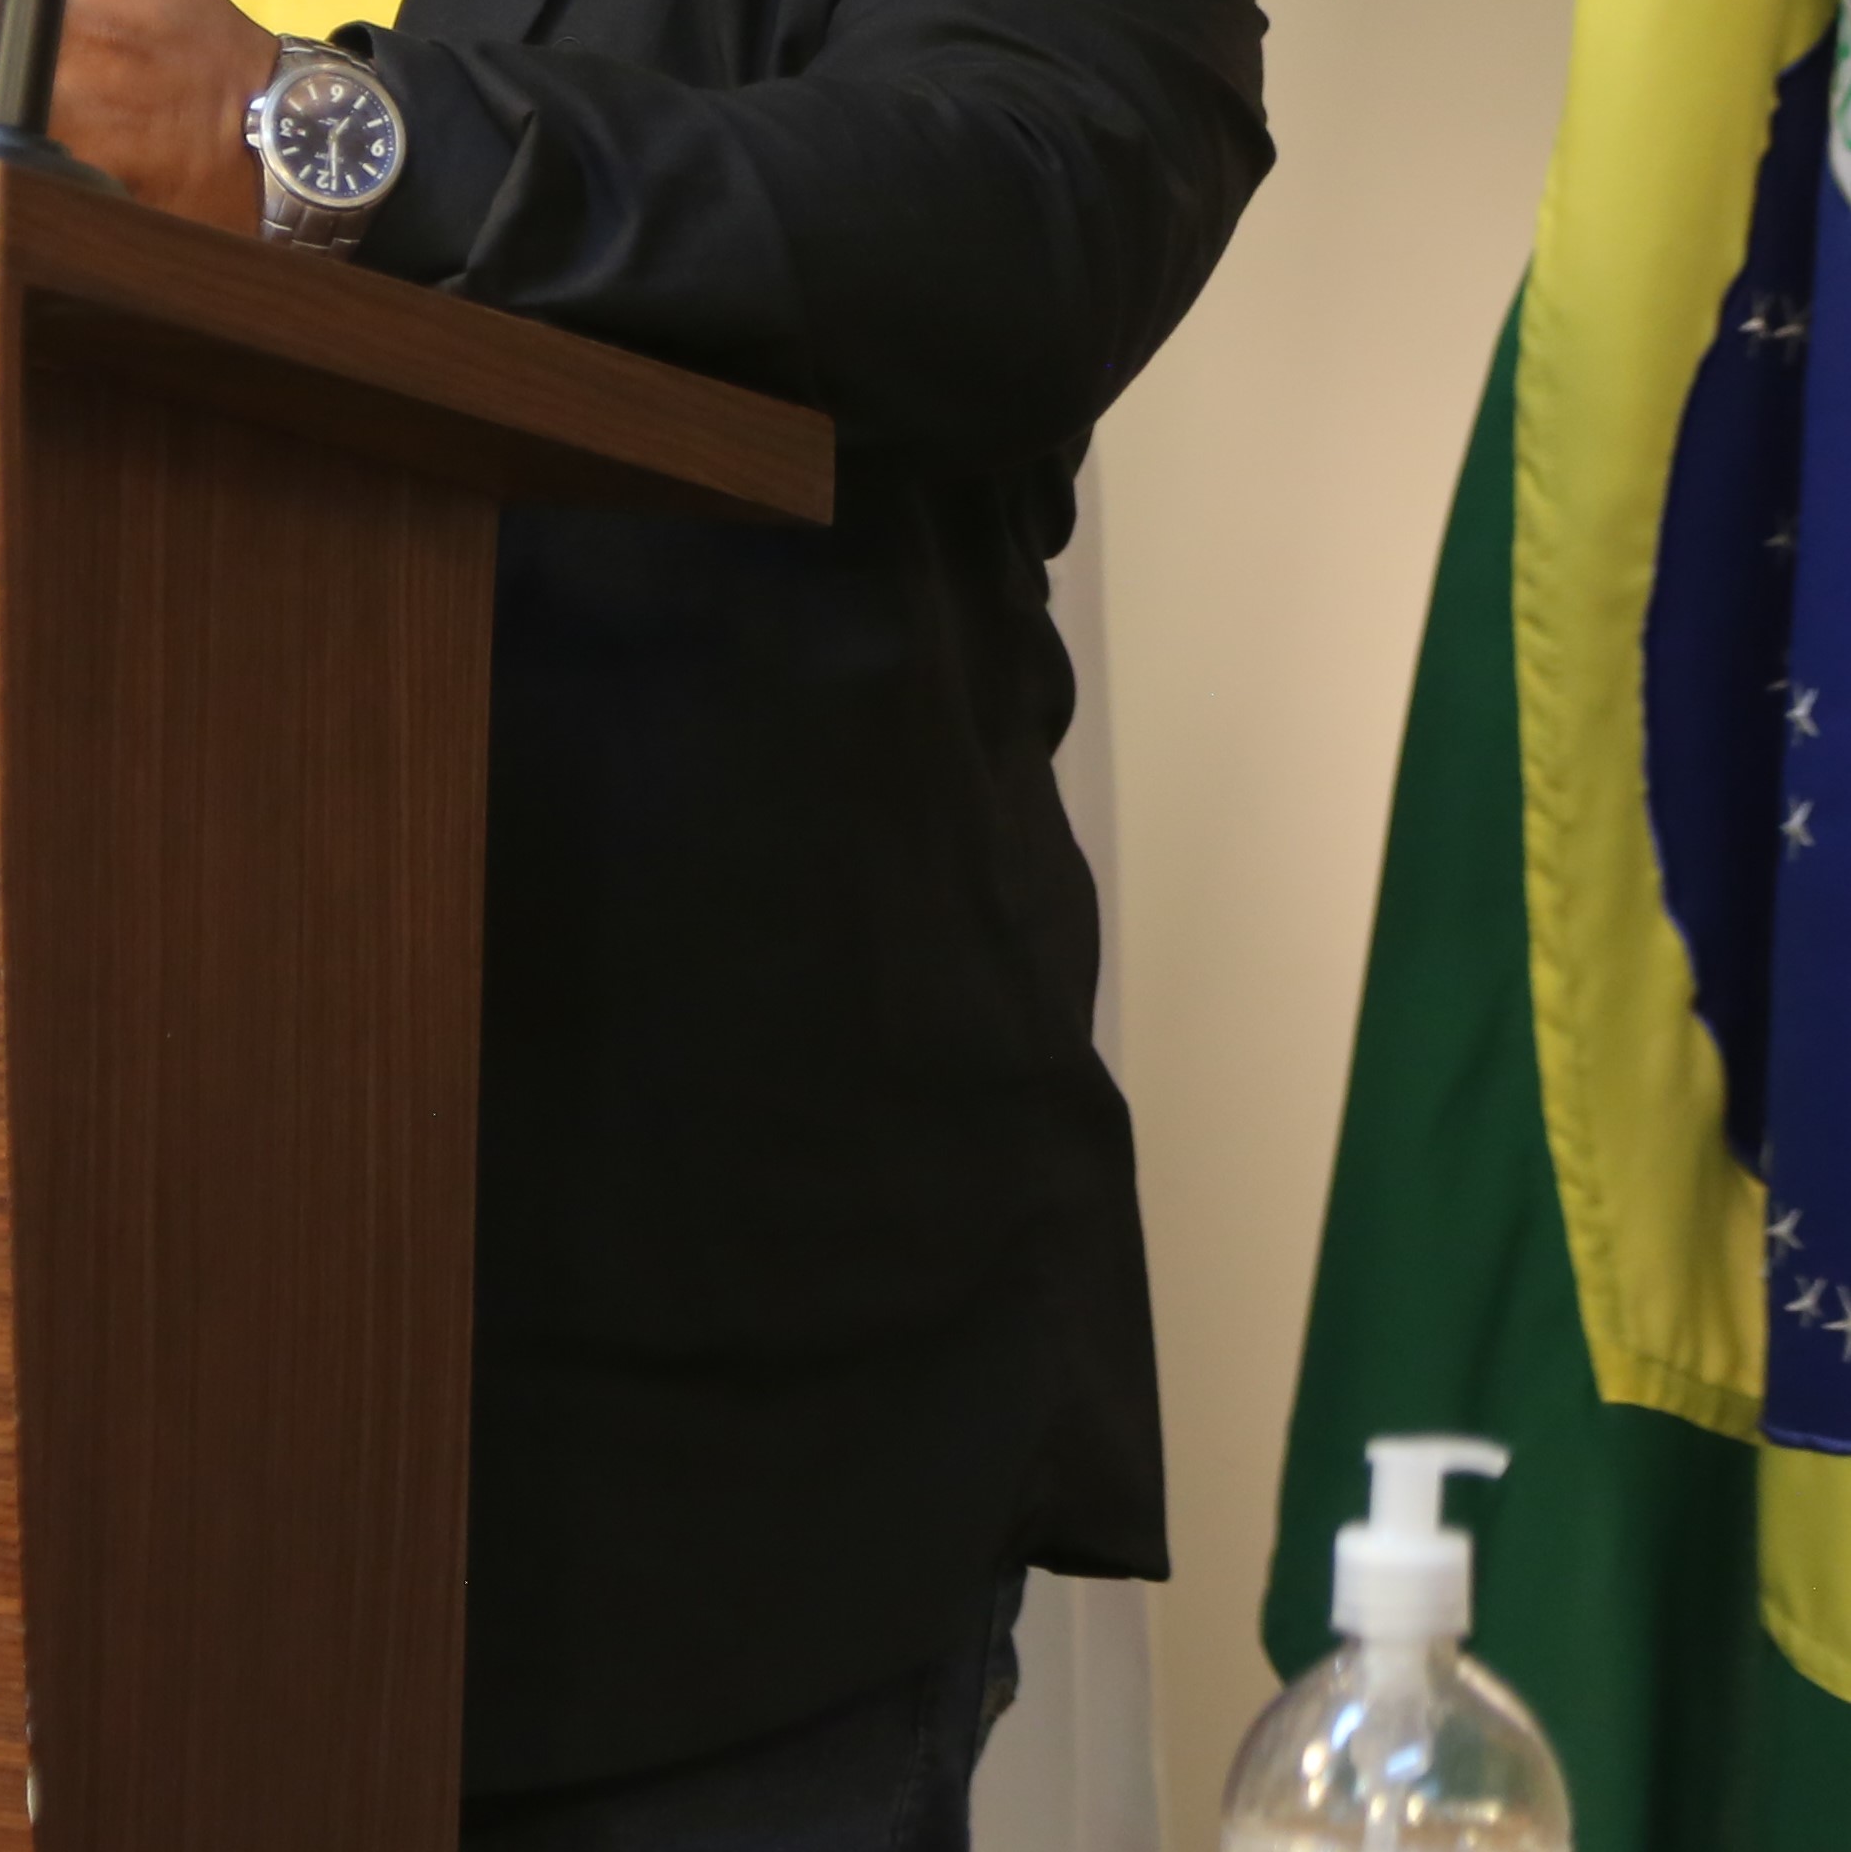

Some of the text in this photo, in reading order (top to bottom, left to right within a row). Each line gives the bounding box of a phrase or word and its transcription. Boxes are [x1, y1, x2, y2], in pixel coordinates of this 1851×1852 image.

[329, 83, 345, 103] 6
[279, 117, 294, 138] 3
[370, 138, 386, 158] 9
[315, 168, 339, 192] 12
